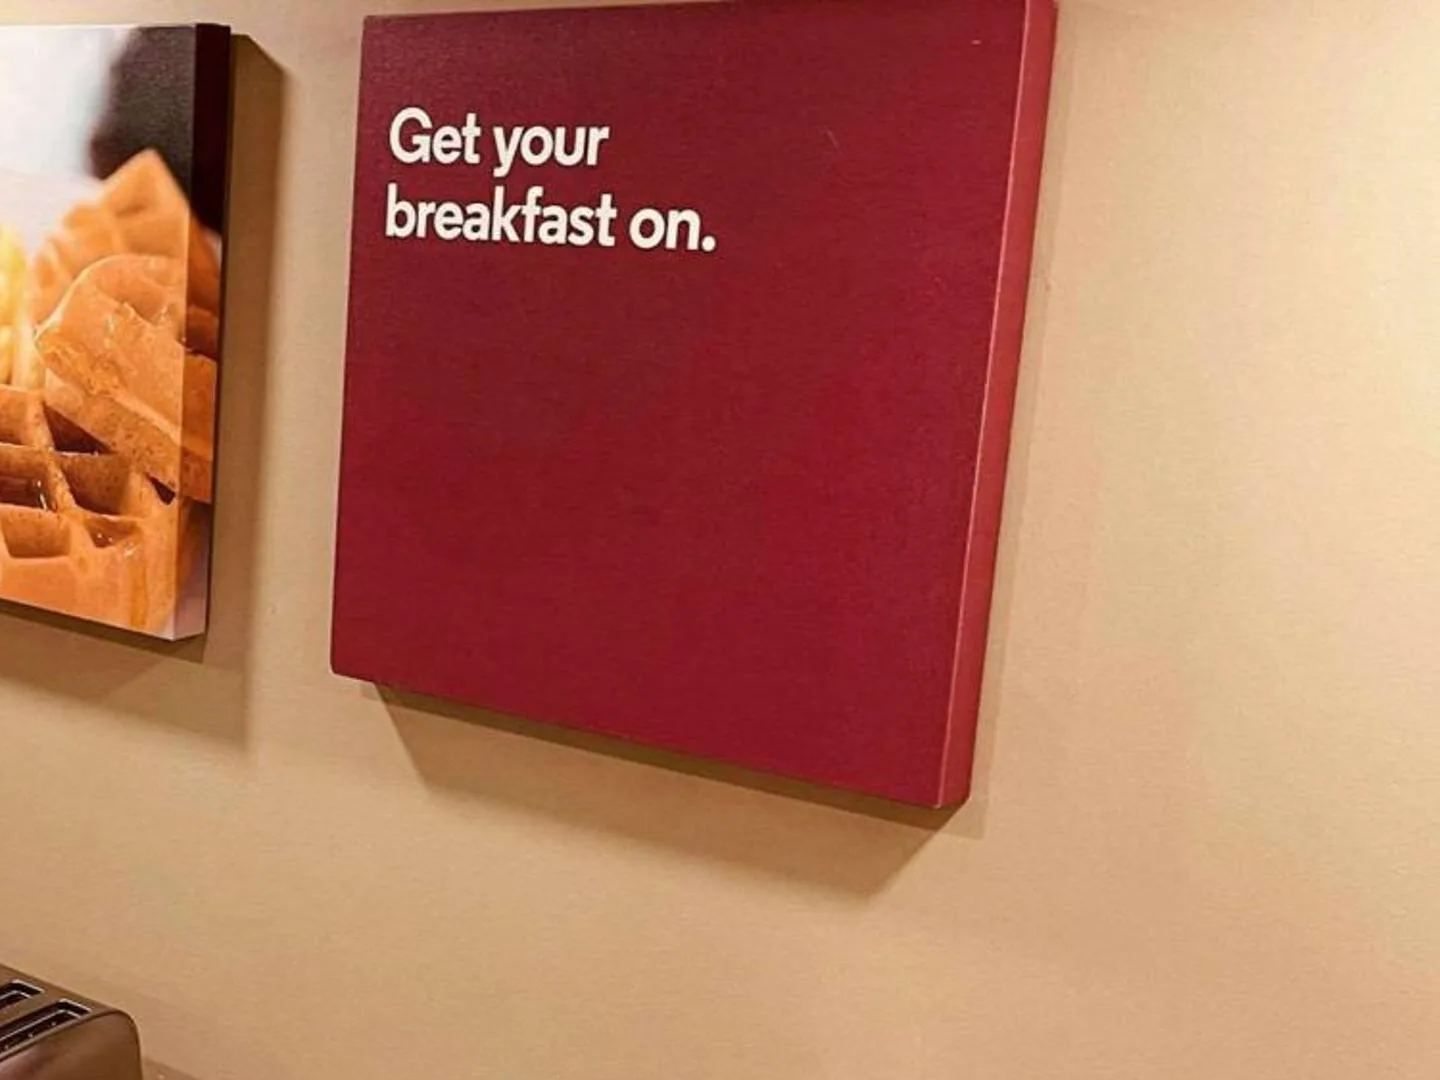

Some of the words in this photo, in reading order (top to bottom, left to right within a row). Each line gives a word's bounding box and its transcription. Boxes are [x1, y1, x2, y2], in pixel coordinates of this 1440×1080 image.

[389, 106, 481, 165] Get
[493, 125, 610, 178] your
[384, 182, 618, 247] breakfast
[628, 205, 718, 253] on.
